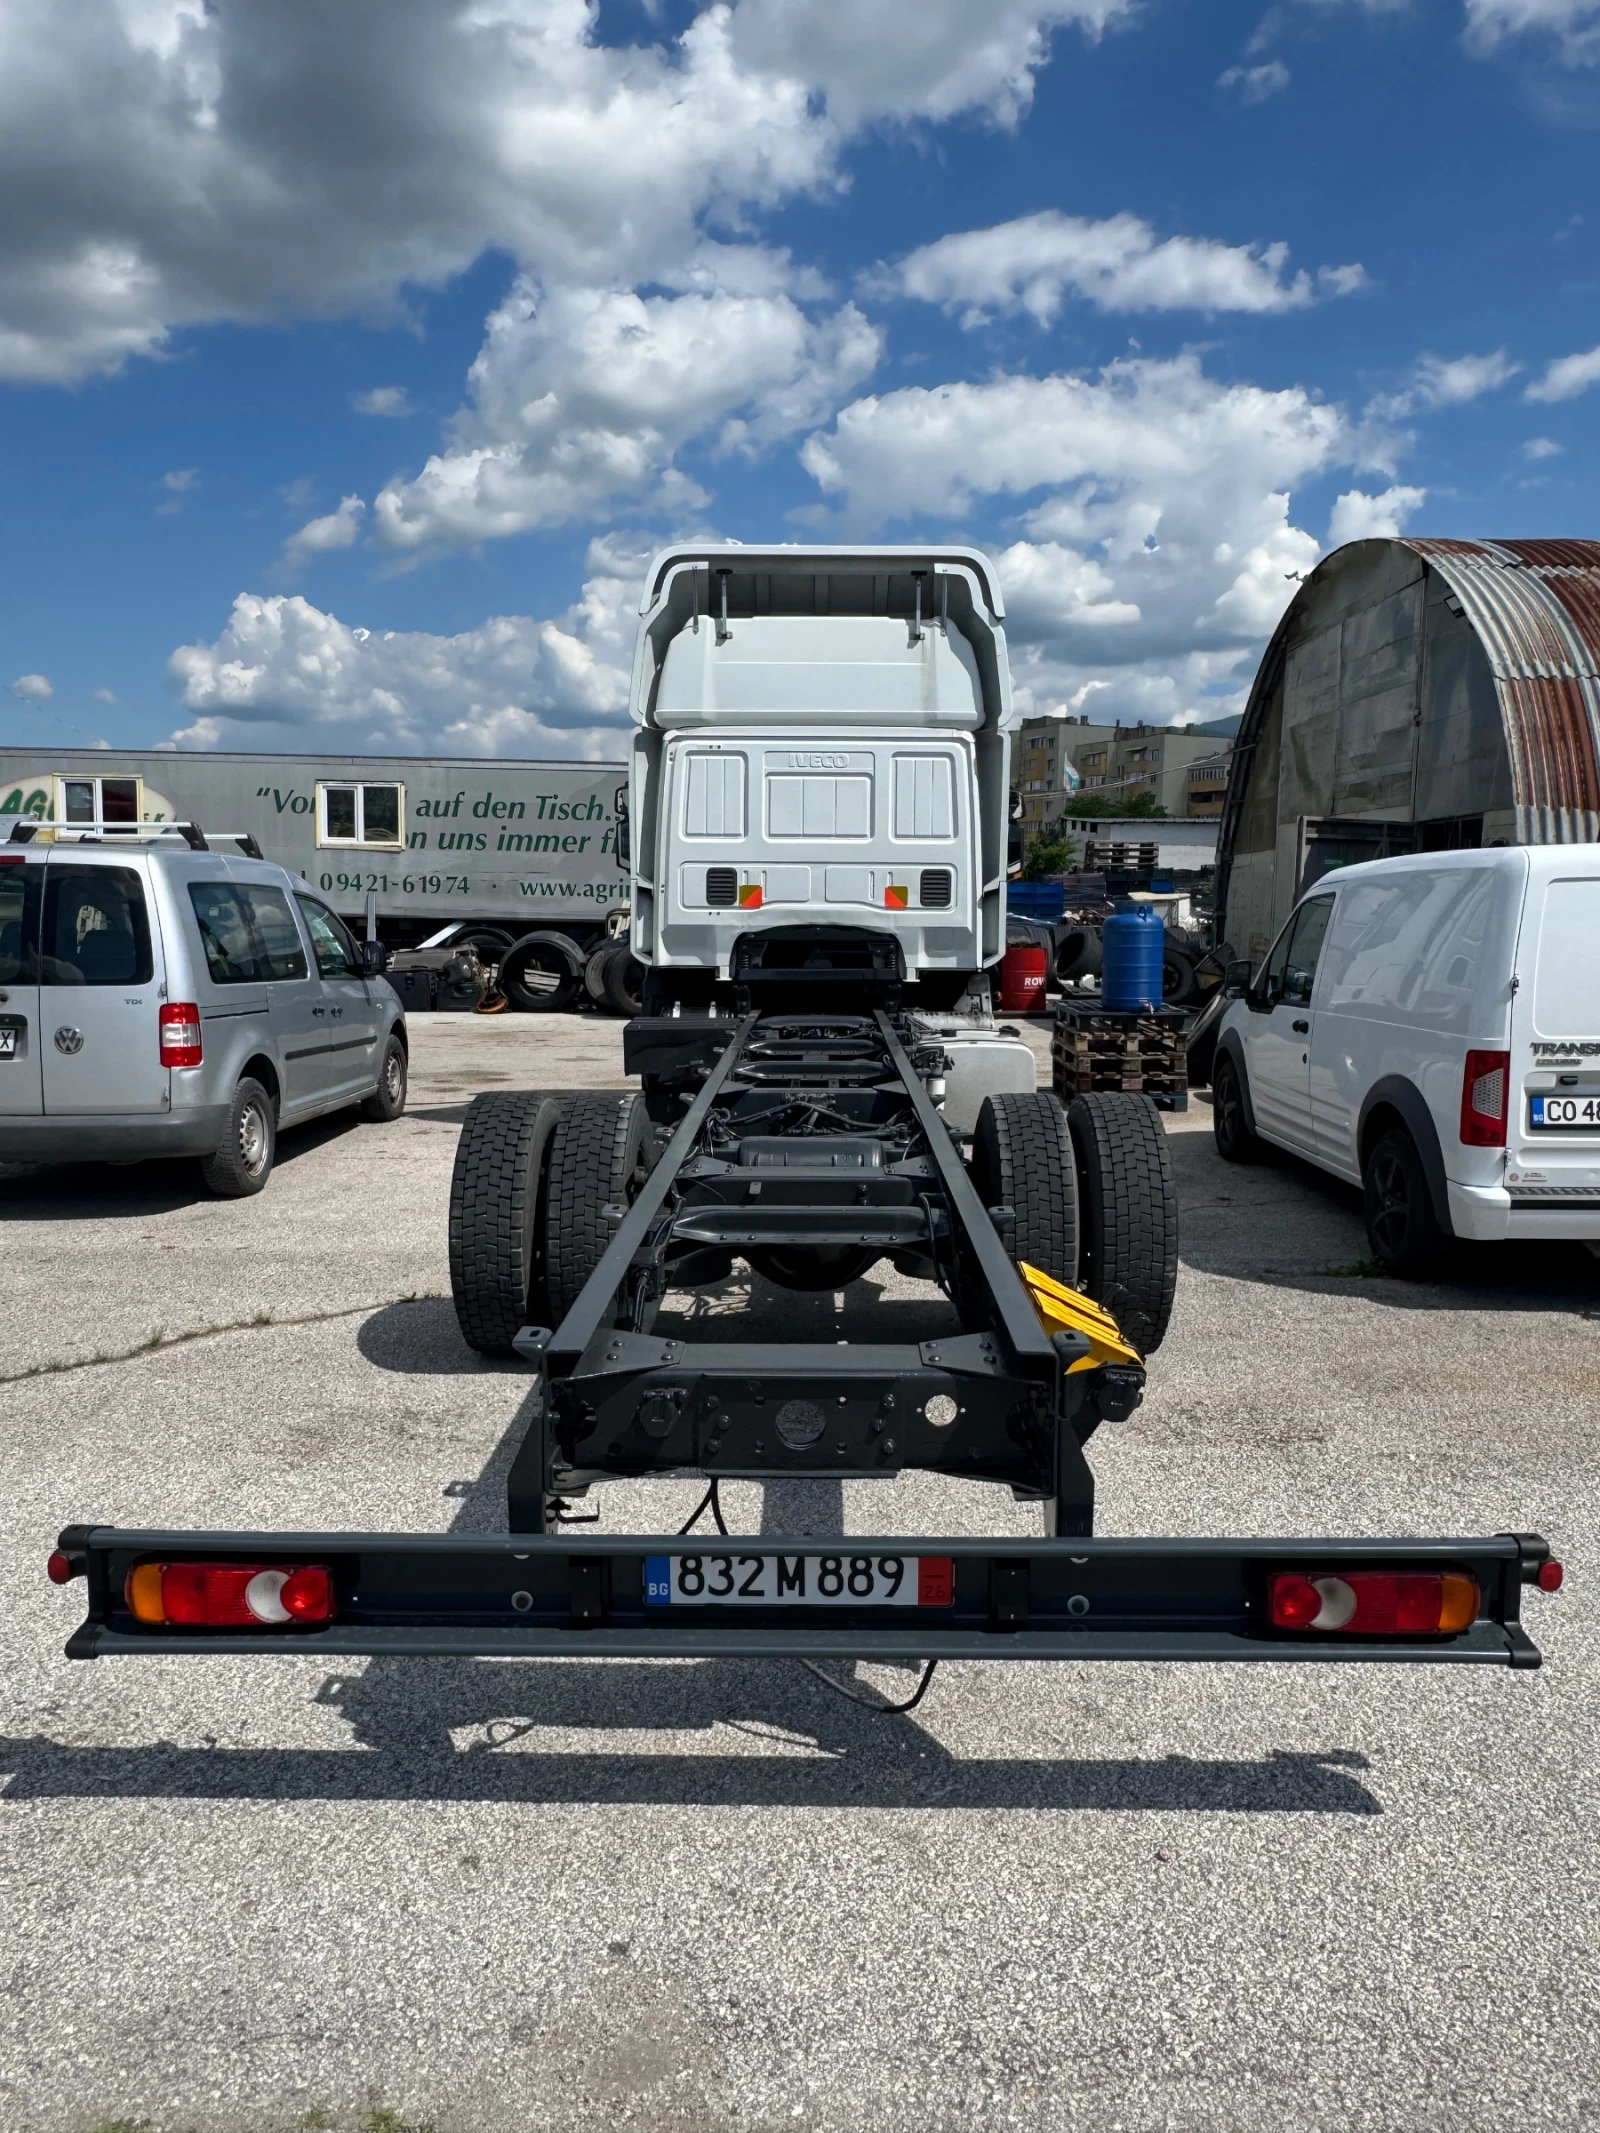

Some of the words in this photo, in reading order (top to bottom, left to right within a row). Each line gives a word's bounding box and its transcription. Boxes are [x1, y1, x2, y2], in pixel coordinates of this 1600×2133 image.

[788, 753, 849, 768] IVECO
[415, 791, 465, 818] auf
[472, 792, 525, 819] den
[438, 832, 487, 851] uns
[497, 825, 592, 853] immer
[1547, 1100, 1577, 1121] CO
[648, 1582, 668, 1596] BG
[677, 1556, 765, 1597] 832
[776, 1556, 806, 1597] M
[817, 1556, 904, 1597] 889
